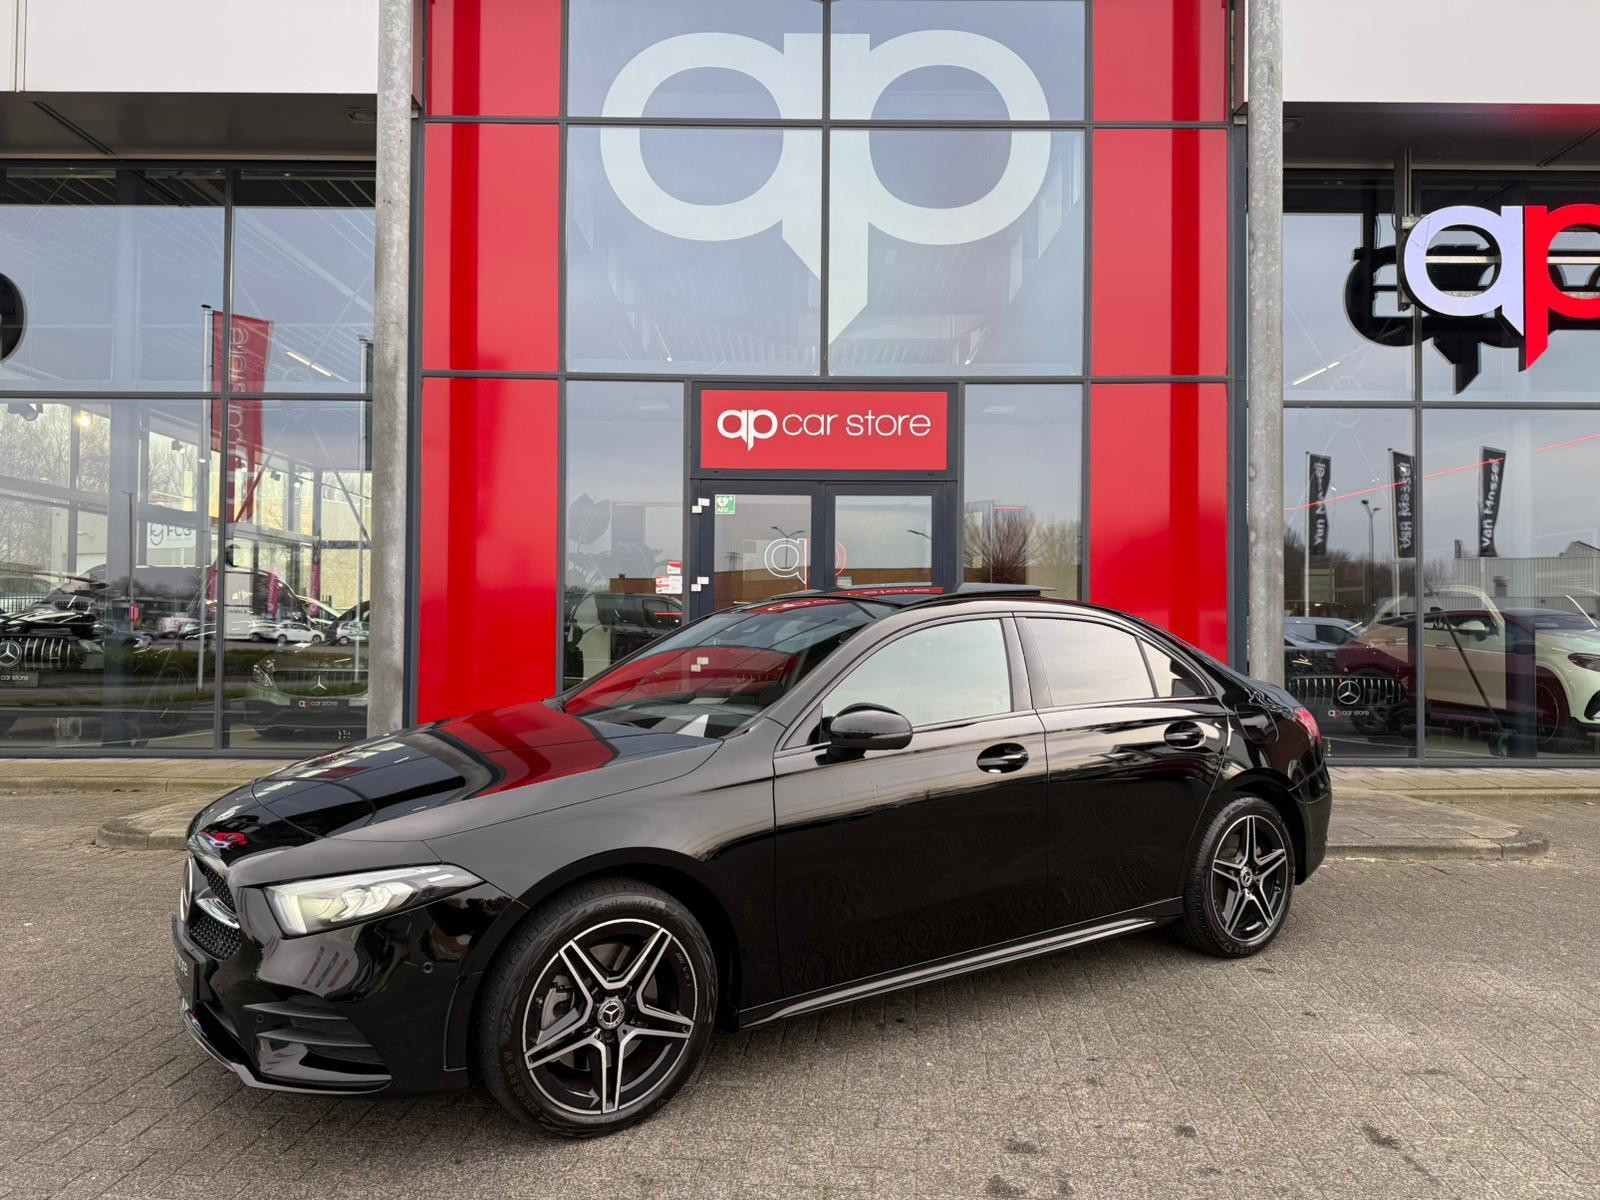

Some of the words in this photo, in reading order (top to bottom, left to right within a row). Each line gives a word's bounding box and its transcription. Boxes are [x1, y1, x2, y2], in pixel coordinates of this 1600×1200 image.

[782, 413, 838, 436] car
[845, 409, 932, 436] store
[1398, 521, 1412, 549] Van
[1481, 518, 1494, 547] Van
